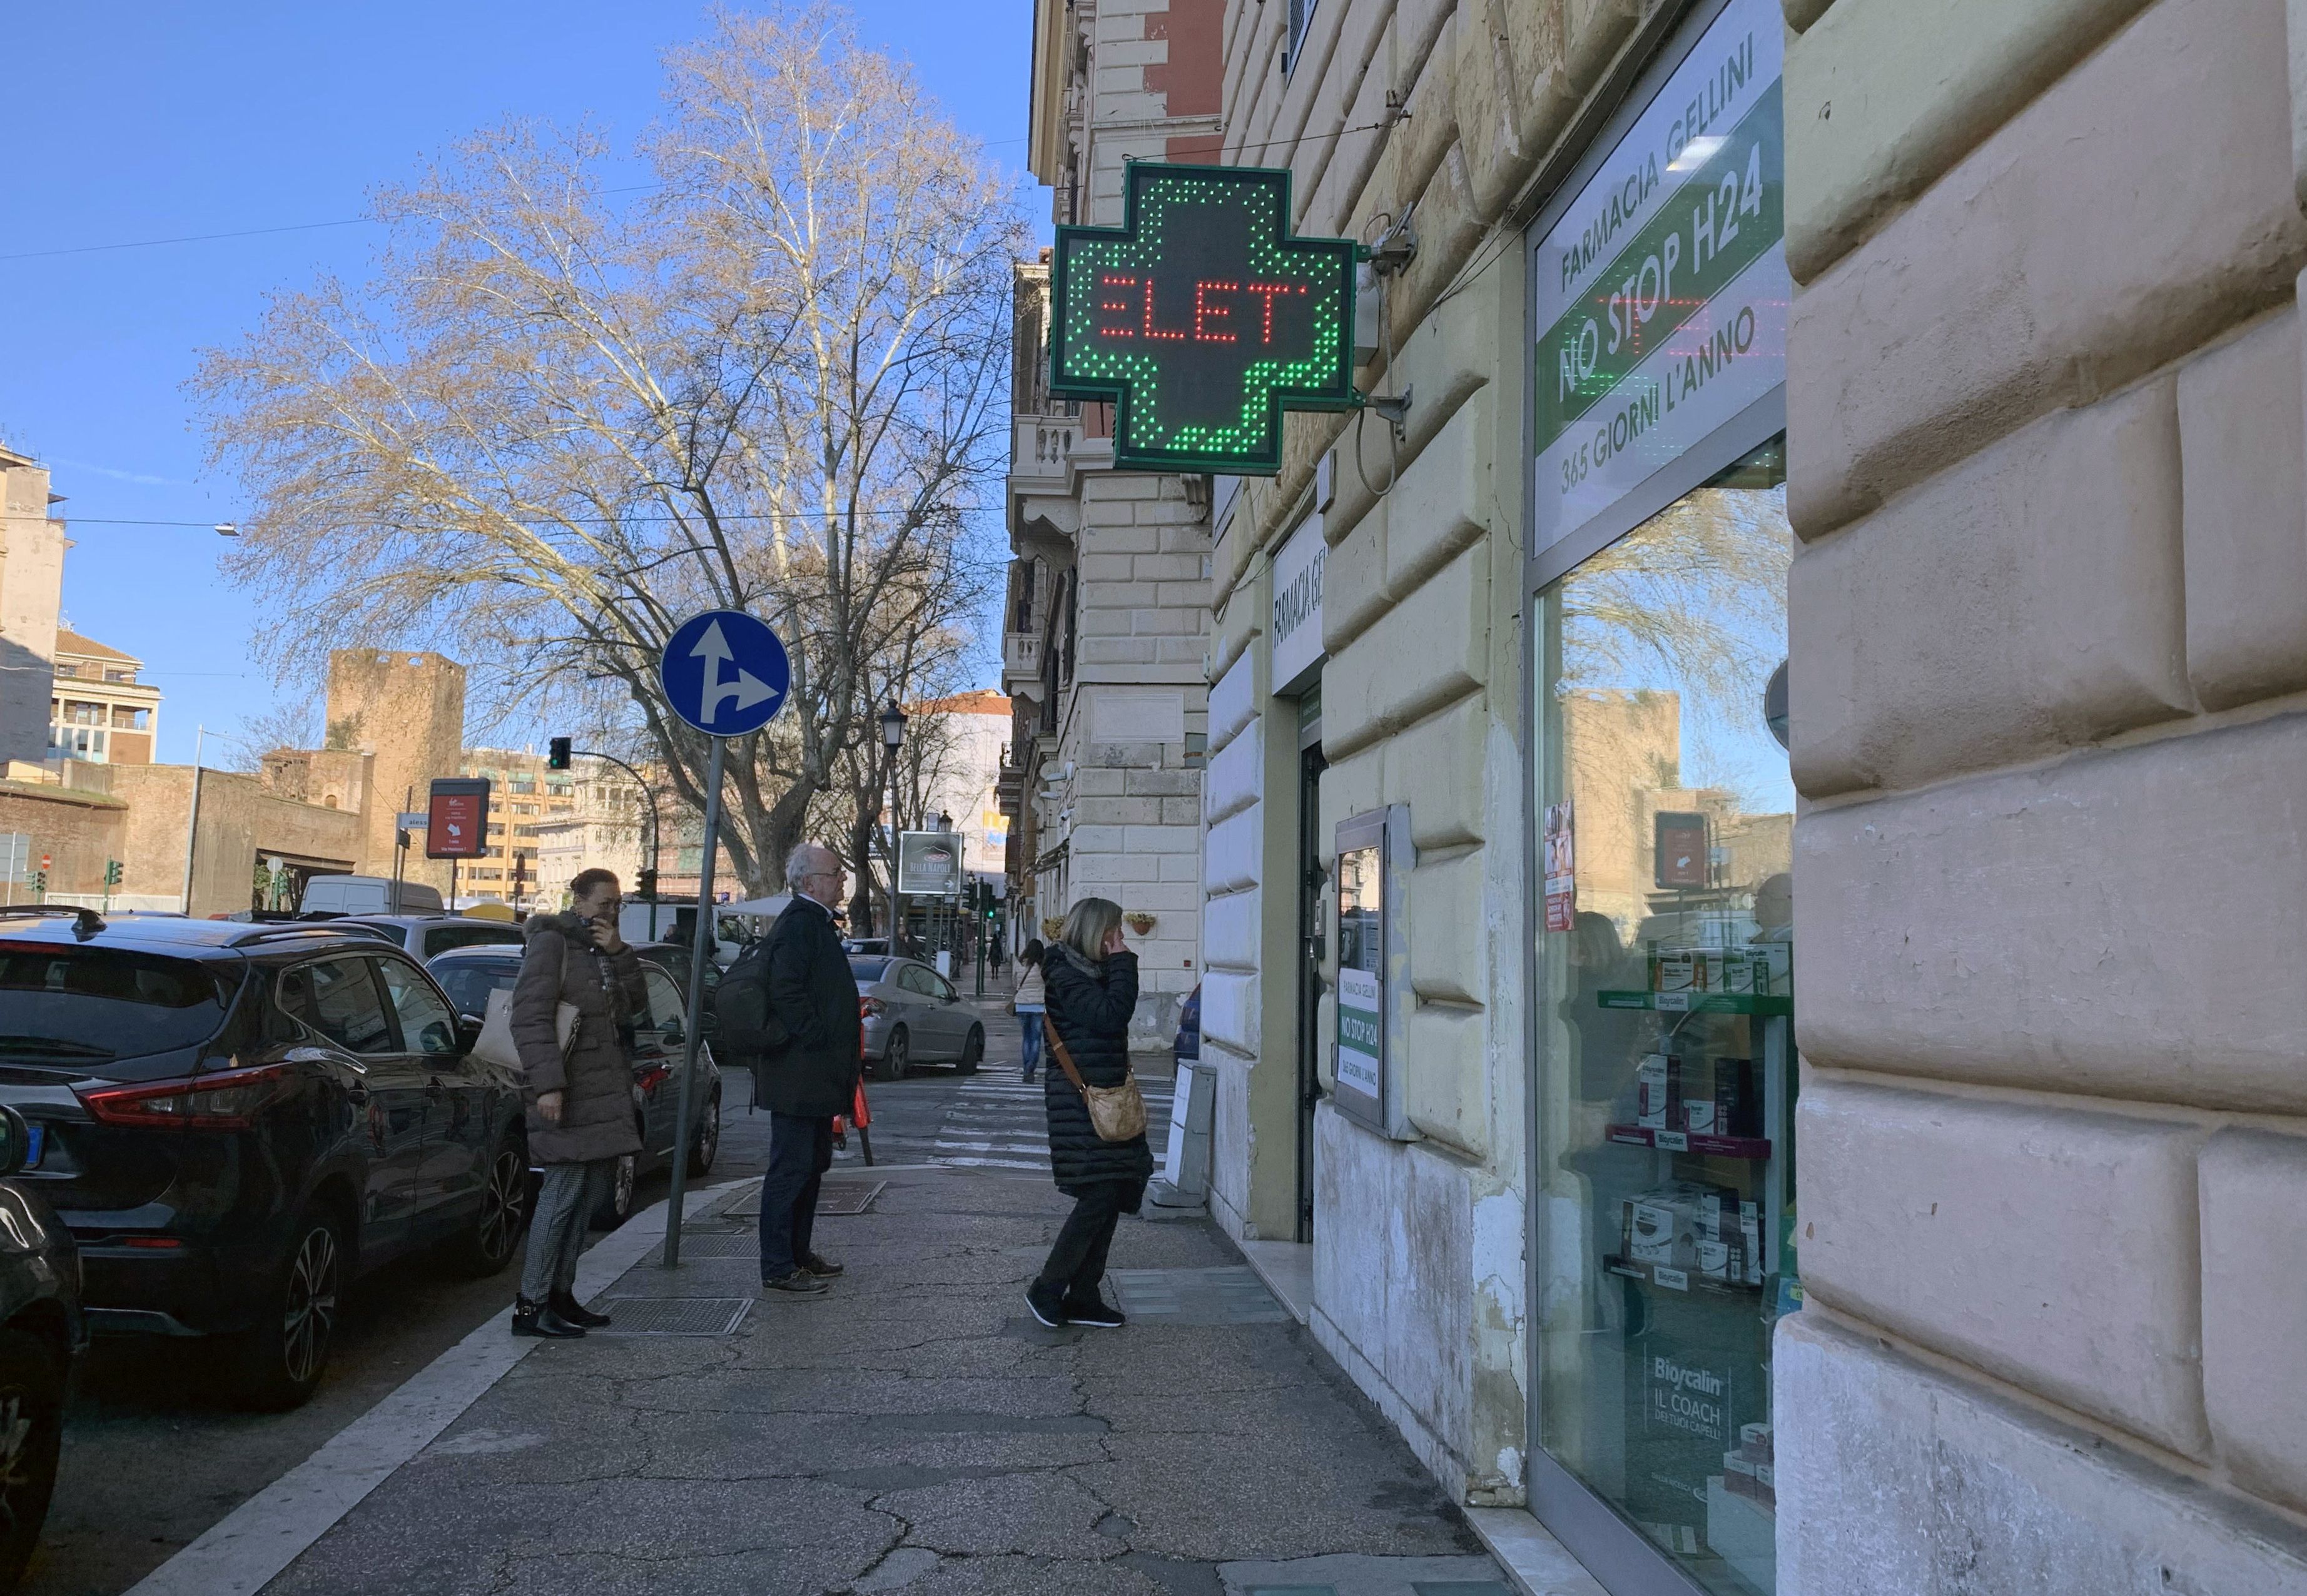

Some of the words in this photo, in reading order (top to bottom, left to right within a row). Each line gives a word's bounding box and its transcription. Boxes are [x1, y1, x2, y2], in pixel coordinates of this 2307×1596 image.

[1561, 151, 1659, 292] FARMACIA
[1666, 32, 1754, 165] GELLINI
[1559, 320, 1599, 403] NO
[1608, 233, 1680, 354] STOP
[1693, 141, 1763, 274] H24
[1561, 440, 1590, 496] 365
[1593, 381, 1660, 470] GIORNI
[1666, 306, 1756, 413] L'ANNO
[1274, 565, 1309, 649] FARMACIA
[910, 862, 926, 872] BELLA
[928, 863, 950, 872] NAPOLI
[1342, 1016, 1350, 1037] NO
[1351, 1018, 1365, 1043] STOP
[1655, 1388, 1666, 1408] IL
[1671, 1393, 1720, 1427] COACH
[1690, 1421, 1721, 1440] CAPELLI
